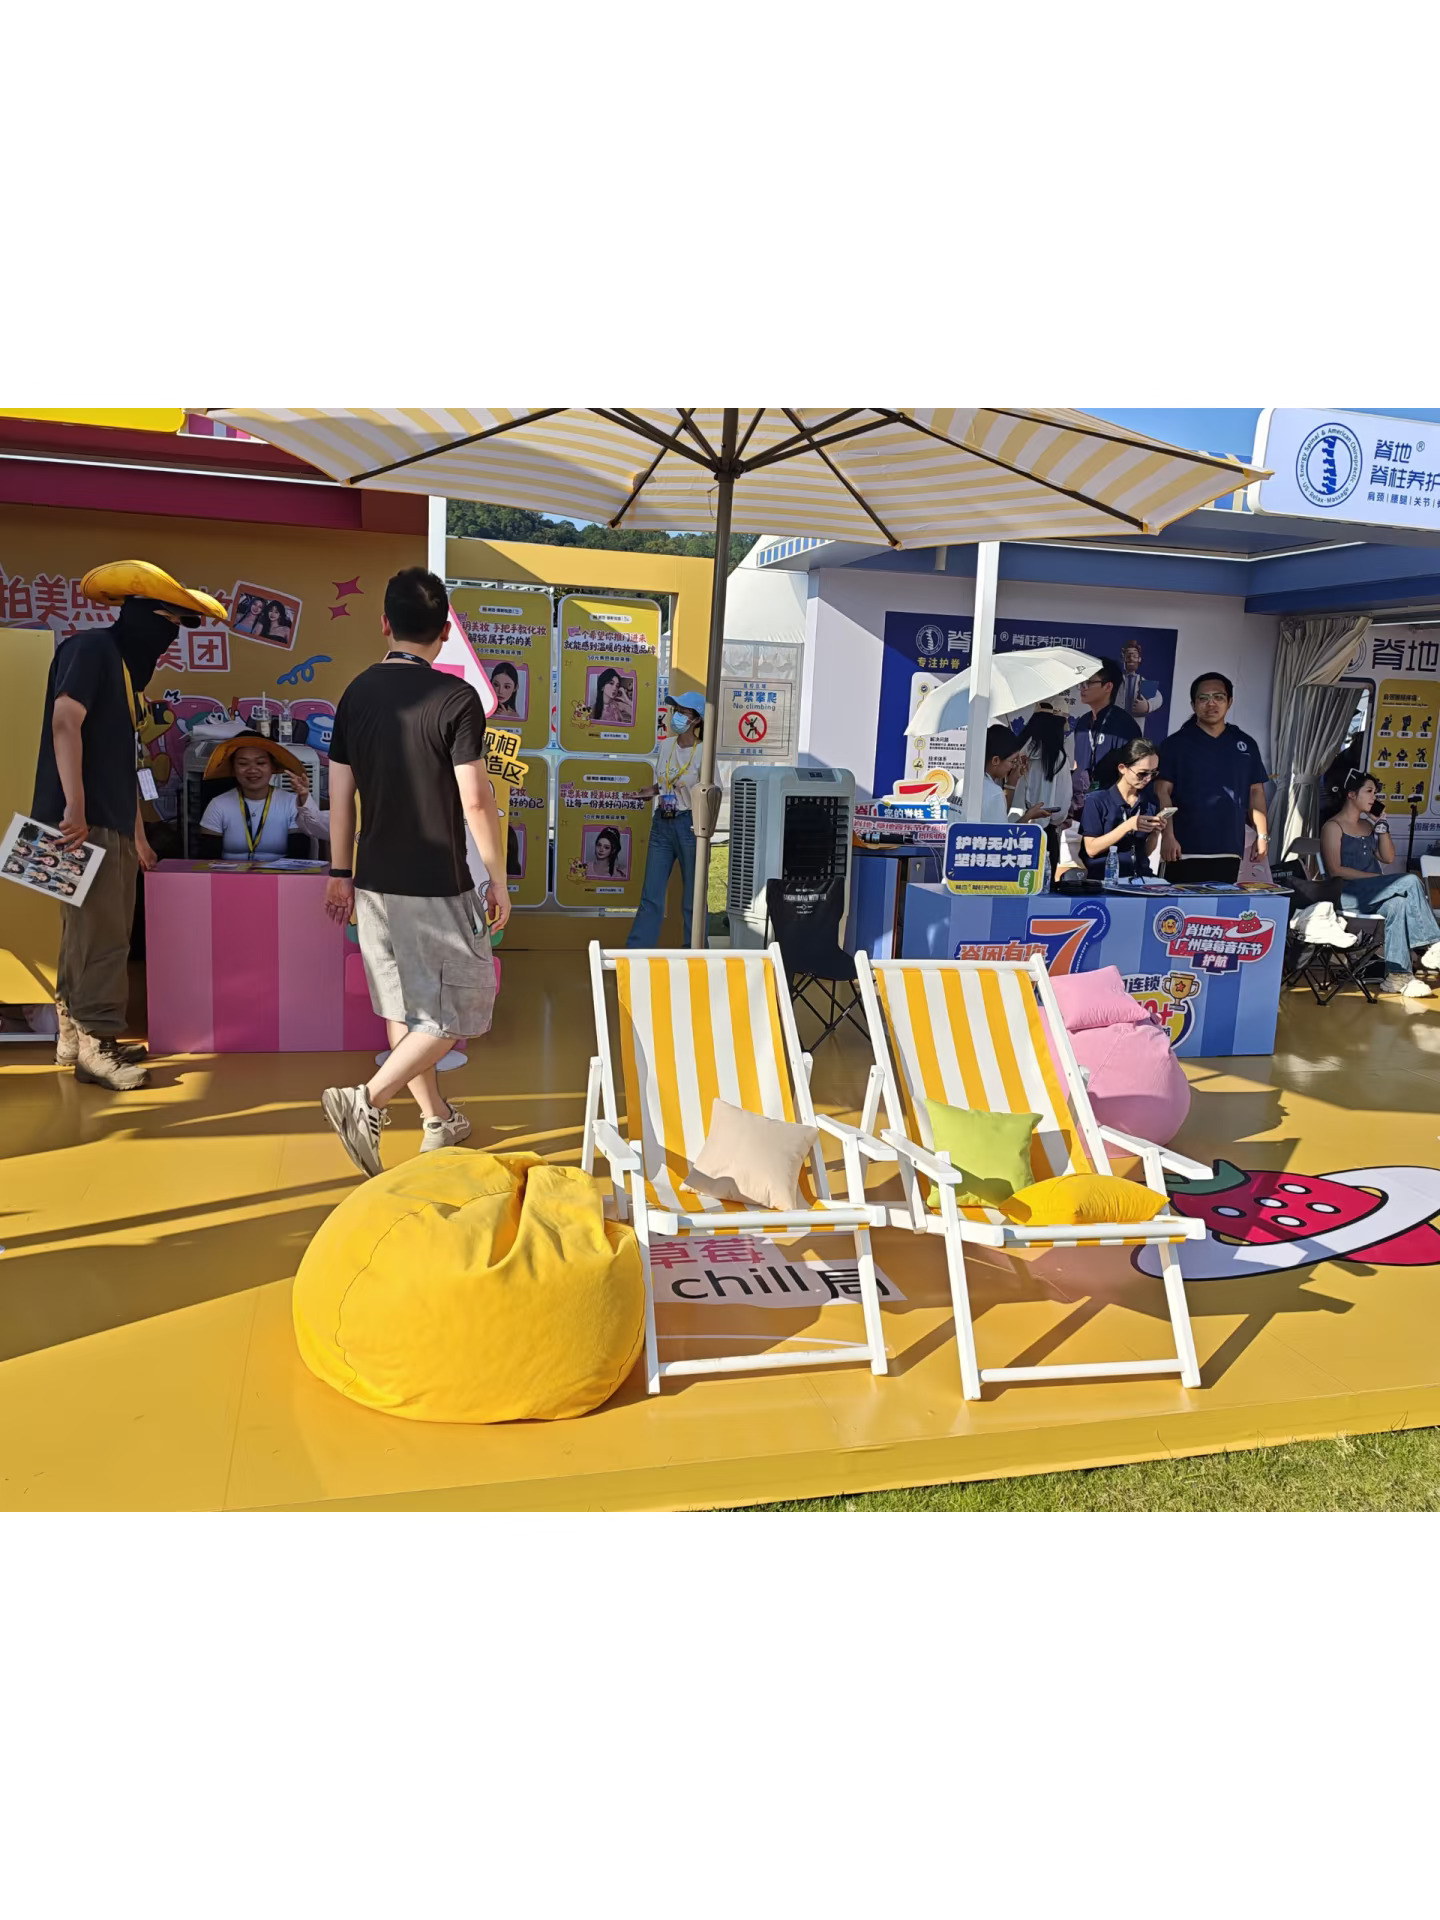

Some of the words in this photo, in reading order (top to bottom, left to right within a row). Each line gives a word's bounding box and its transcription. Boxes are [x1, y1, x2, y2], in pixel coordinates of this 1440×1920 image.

[1304, 432, 1320, 451] Spinal
[1328, 428, 1352, 443] American
[1372, 637, 1439, 673] 脊地
[732, 690, 777, 703] 严禁攀爬
[733, 702, 744, 710] No
[745, 703, 776, 711] climbing
[955, 835, 1034, 851] 护脊无小事
[954, 853, 1033, 868] 坚持是大事
[1185, 923, 1224, 938] 脊地为
[1175, 938, 1263, 956] 广州草莓音乐节
[1201, 954, 1229, 969] 护航
